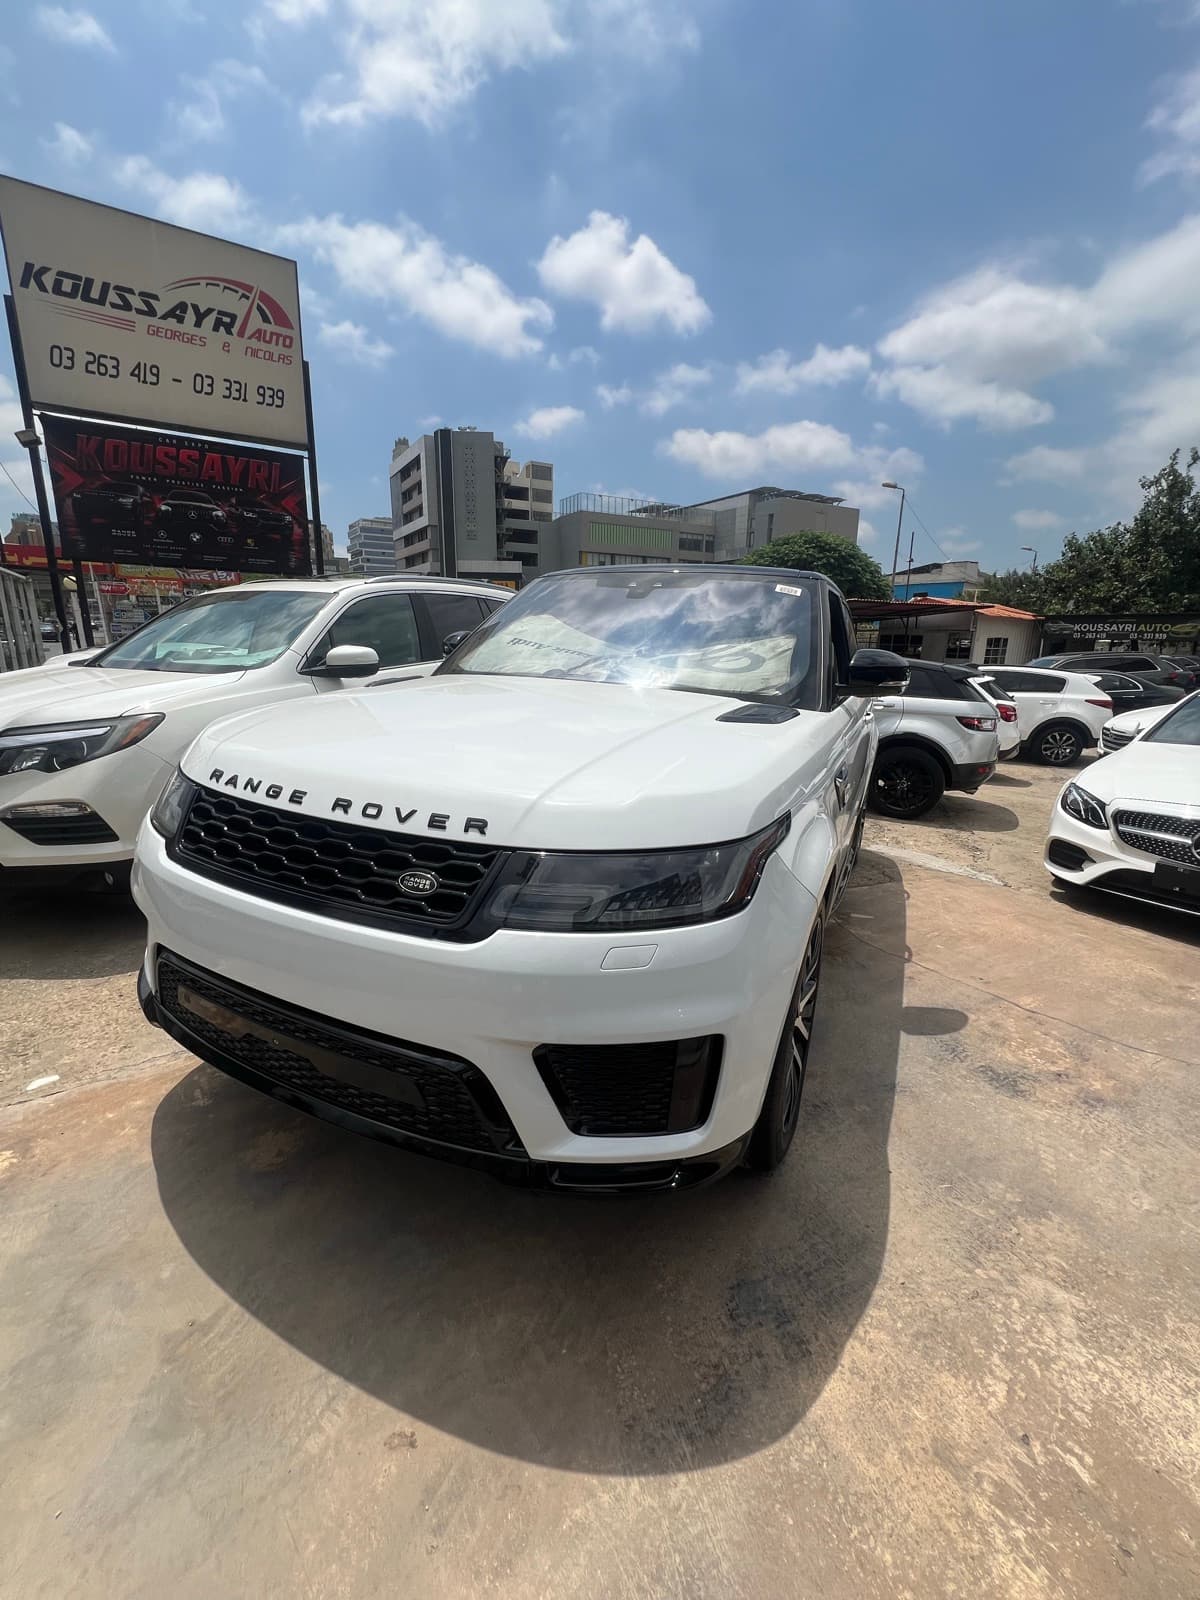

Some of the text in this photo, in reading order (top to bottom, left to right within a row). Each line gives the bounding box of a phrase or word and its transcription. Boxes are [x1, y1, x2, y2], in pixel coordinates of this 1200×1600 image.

[147, 324, 293, 366] GEORGES & NICOLAS
[248, 328, 294, 349] AUTO
[50, 344, 75, 371] 03
[85, 350, 120, 379] 263
[130, 361, 160, 386] 419
[193, 373, 214, 396] 03
[222, 378, 248, 402] 331
[256, 385, 285, 408] 939
[76, 434, 281, 493] KOUSSAYRI
[1073, 623, 1172, 632] KOUSSAYRI AUTO
[209, 768, 489, 835] RANGE ROVER
[403, 880, 430, 890] ROVER
[404, 875, 431, 885] RANGE
